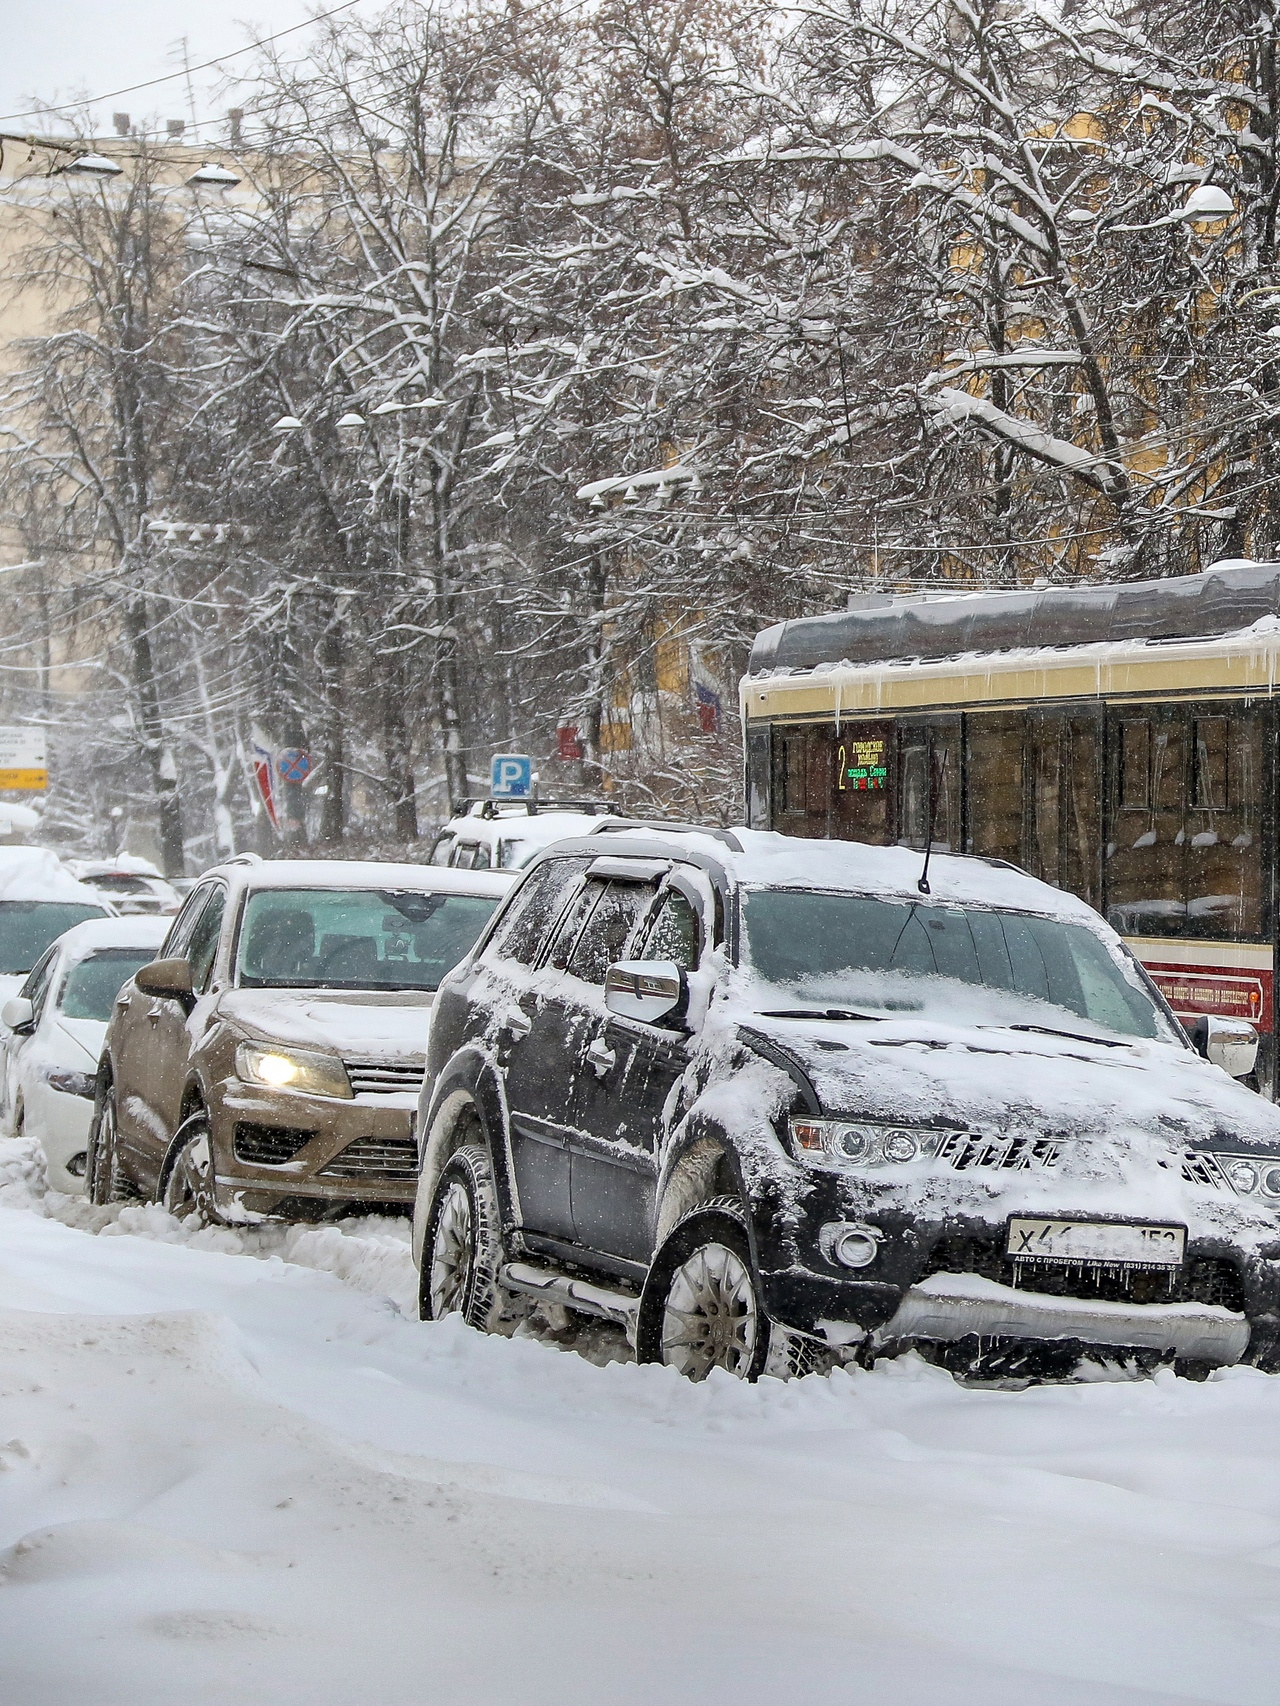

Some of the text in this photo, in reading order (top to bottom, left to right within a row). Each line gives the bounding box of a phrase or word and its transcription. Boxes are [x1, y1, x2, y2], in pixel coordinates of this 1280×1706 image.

[852, 740, 884, 754] ГОРОДСКОЕ
[501, 761, 523, 792] P
[838, 745, 846, 790] 2
[1014, 1255, 1035, 1263] АВТО
[1043, 1257, 1084, 1266] ПРОБЕГОМ
[1123, 1262, 1142, 1270] (831)
